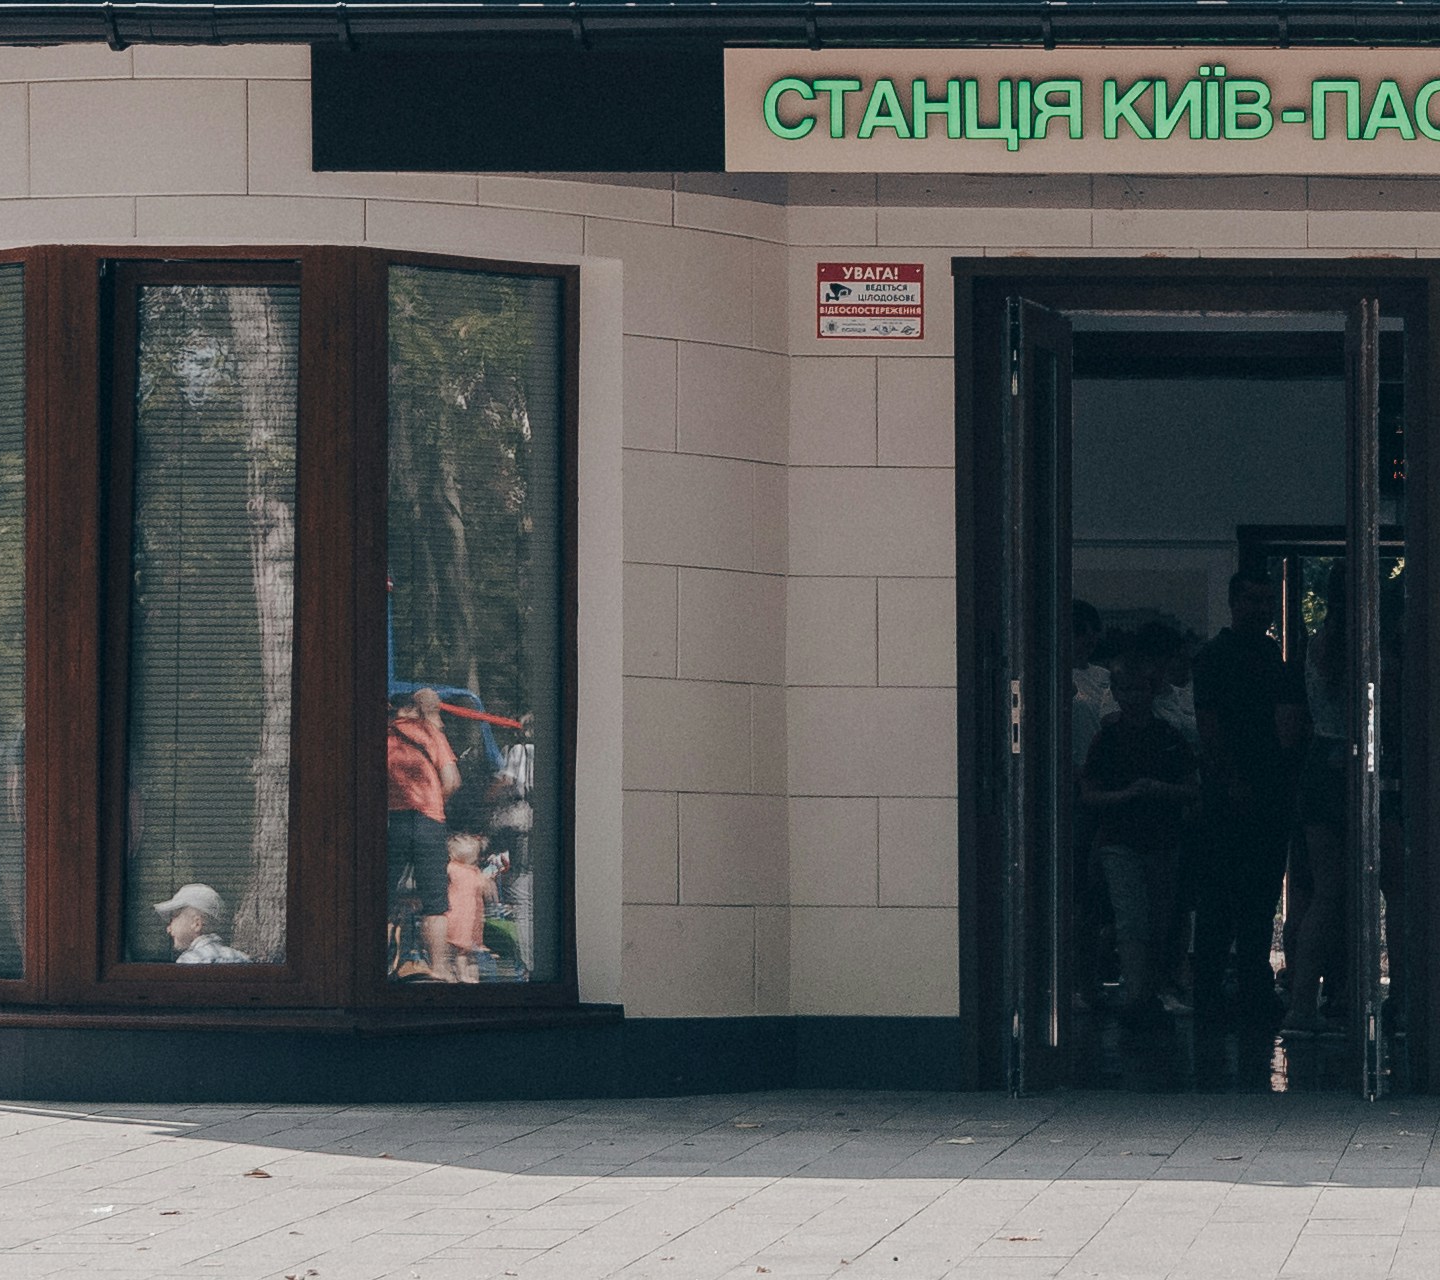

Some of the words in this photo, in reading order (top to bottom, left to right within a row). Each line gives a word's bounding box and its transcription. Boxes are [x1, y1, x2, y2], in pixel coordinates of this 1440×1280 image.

[763, 76, 1084, 152] СТАНЦІЯ
[842, 266, 899, 281] УВАГА!
[865, 283, 908, 292] ВЕДЕТЬСЯ
[819, 306, 922, 316] ВІДЕОСПОСТЕРЕЖЕННЯ
